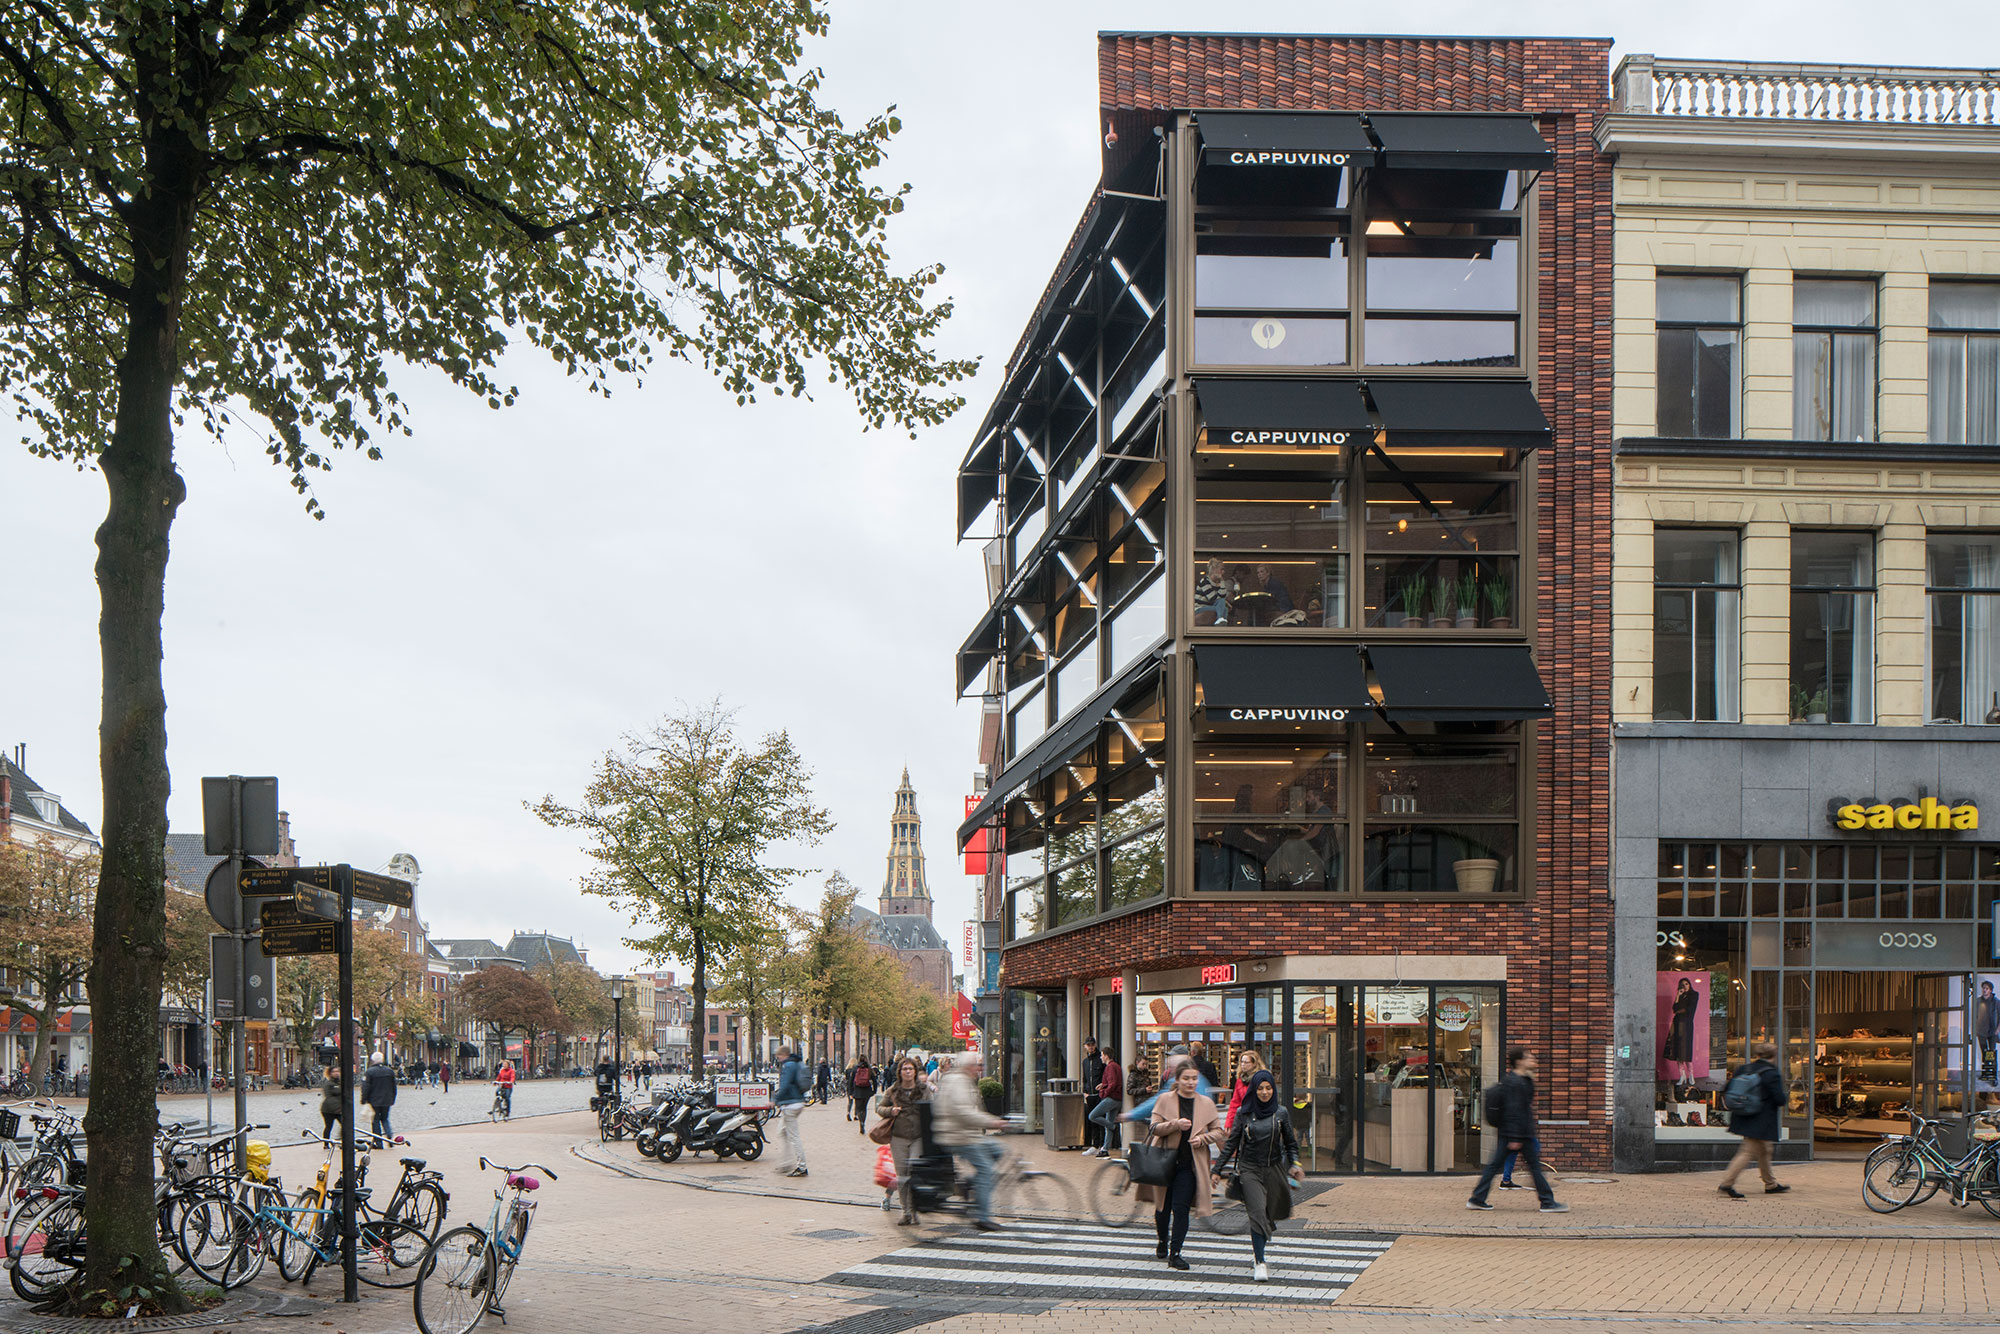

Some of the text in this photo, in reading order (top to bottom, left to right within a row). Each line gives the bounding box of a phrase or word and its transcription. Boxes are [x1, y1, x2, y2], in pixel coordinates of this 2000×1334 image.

[1230, 151, 1346, 165] CAPPUVINO
[1230, 431, 1346, 444] CAPPUVINO
[1230, 708, 1345, 721] CAPPUVINO
[967, 801, 981, 811] PER
[1836, 797, 1979, 831] sacha
[965, 925, 973, 962] BRISTOL
[1201, 964, 1231, 985] FEBO
[1443, 1004, 1461, 1012] GRILL
[1439, 1012, 1465, 1020] BURGER
[742, 1088, 767, 1096] FEBO
